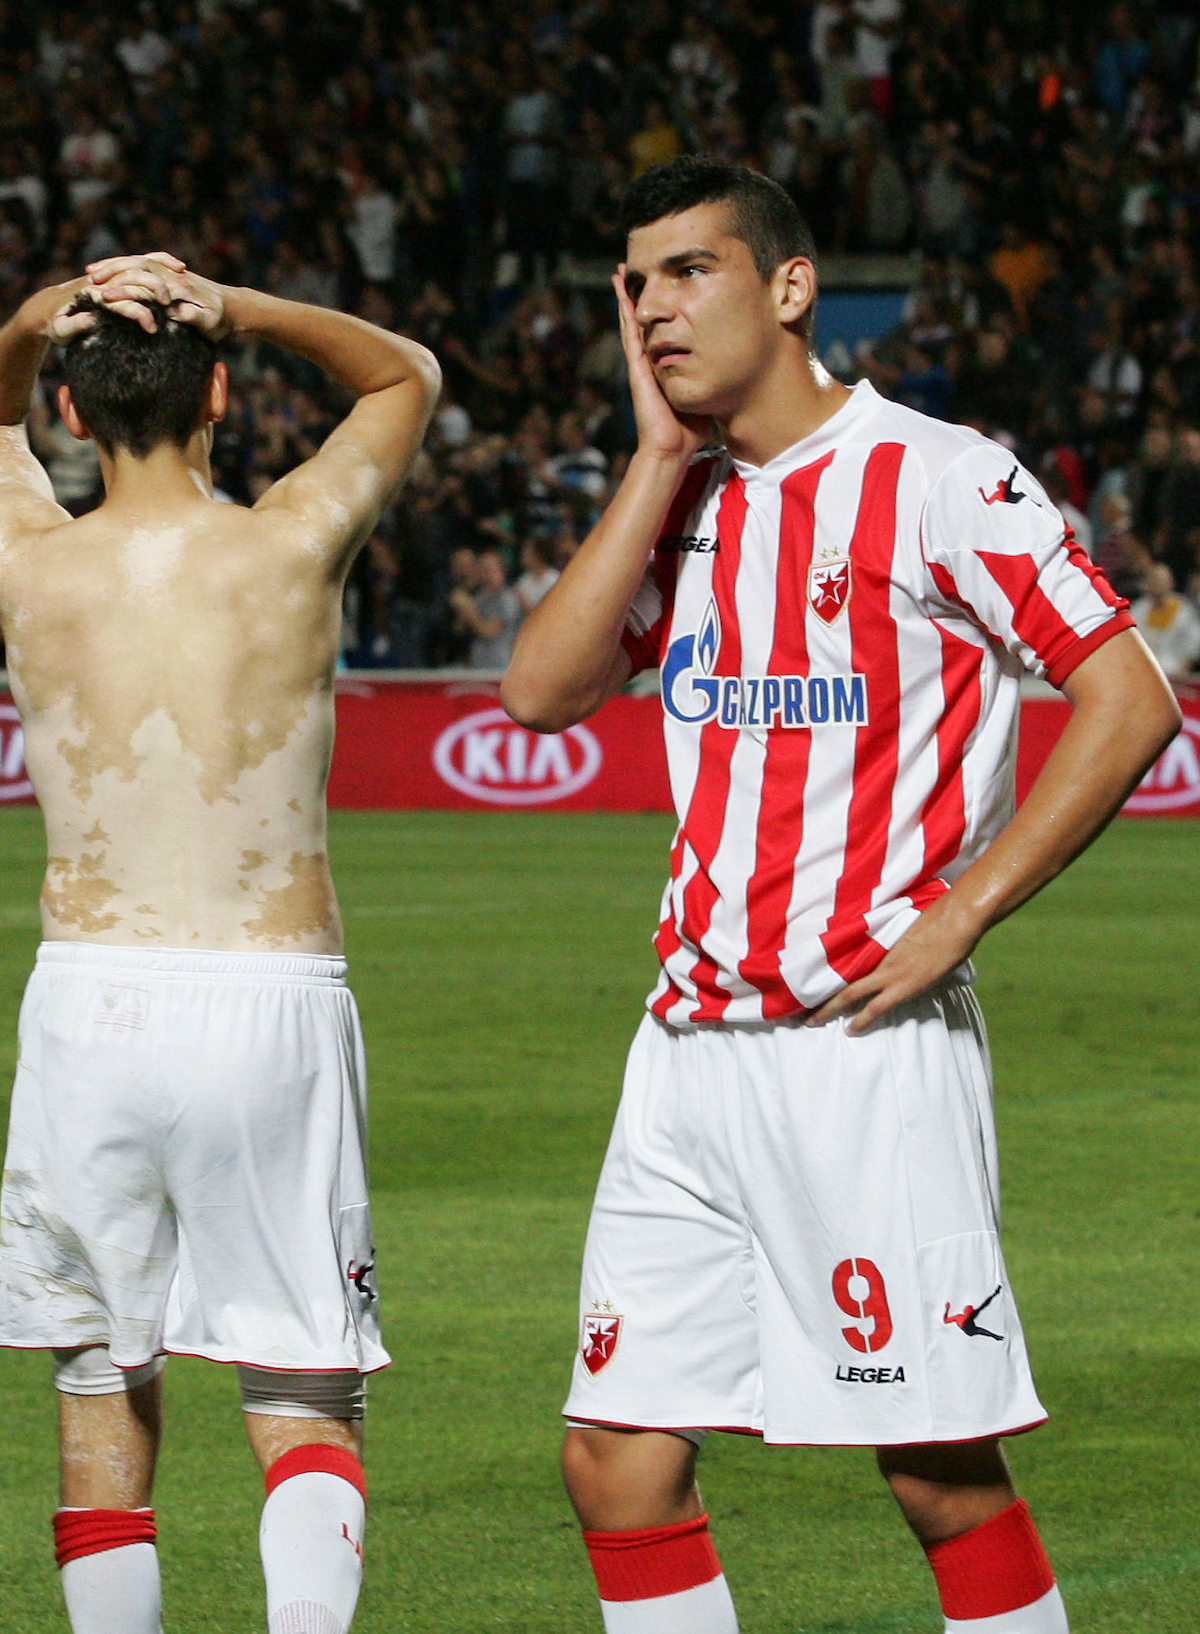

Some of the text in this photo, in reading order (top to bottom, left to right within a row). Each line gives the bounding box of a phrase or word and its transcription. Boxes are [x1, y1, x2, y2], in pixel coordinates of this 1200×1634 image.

[720, 676, 866, 727] GAZPROM
[463, 730, 573, 783] KIA
[831, 1257, 893, 1354] 9
[835, 1364, 906, 1384] LEGEA
